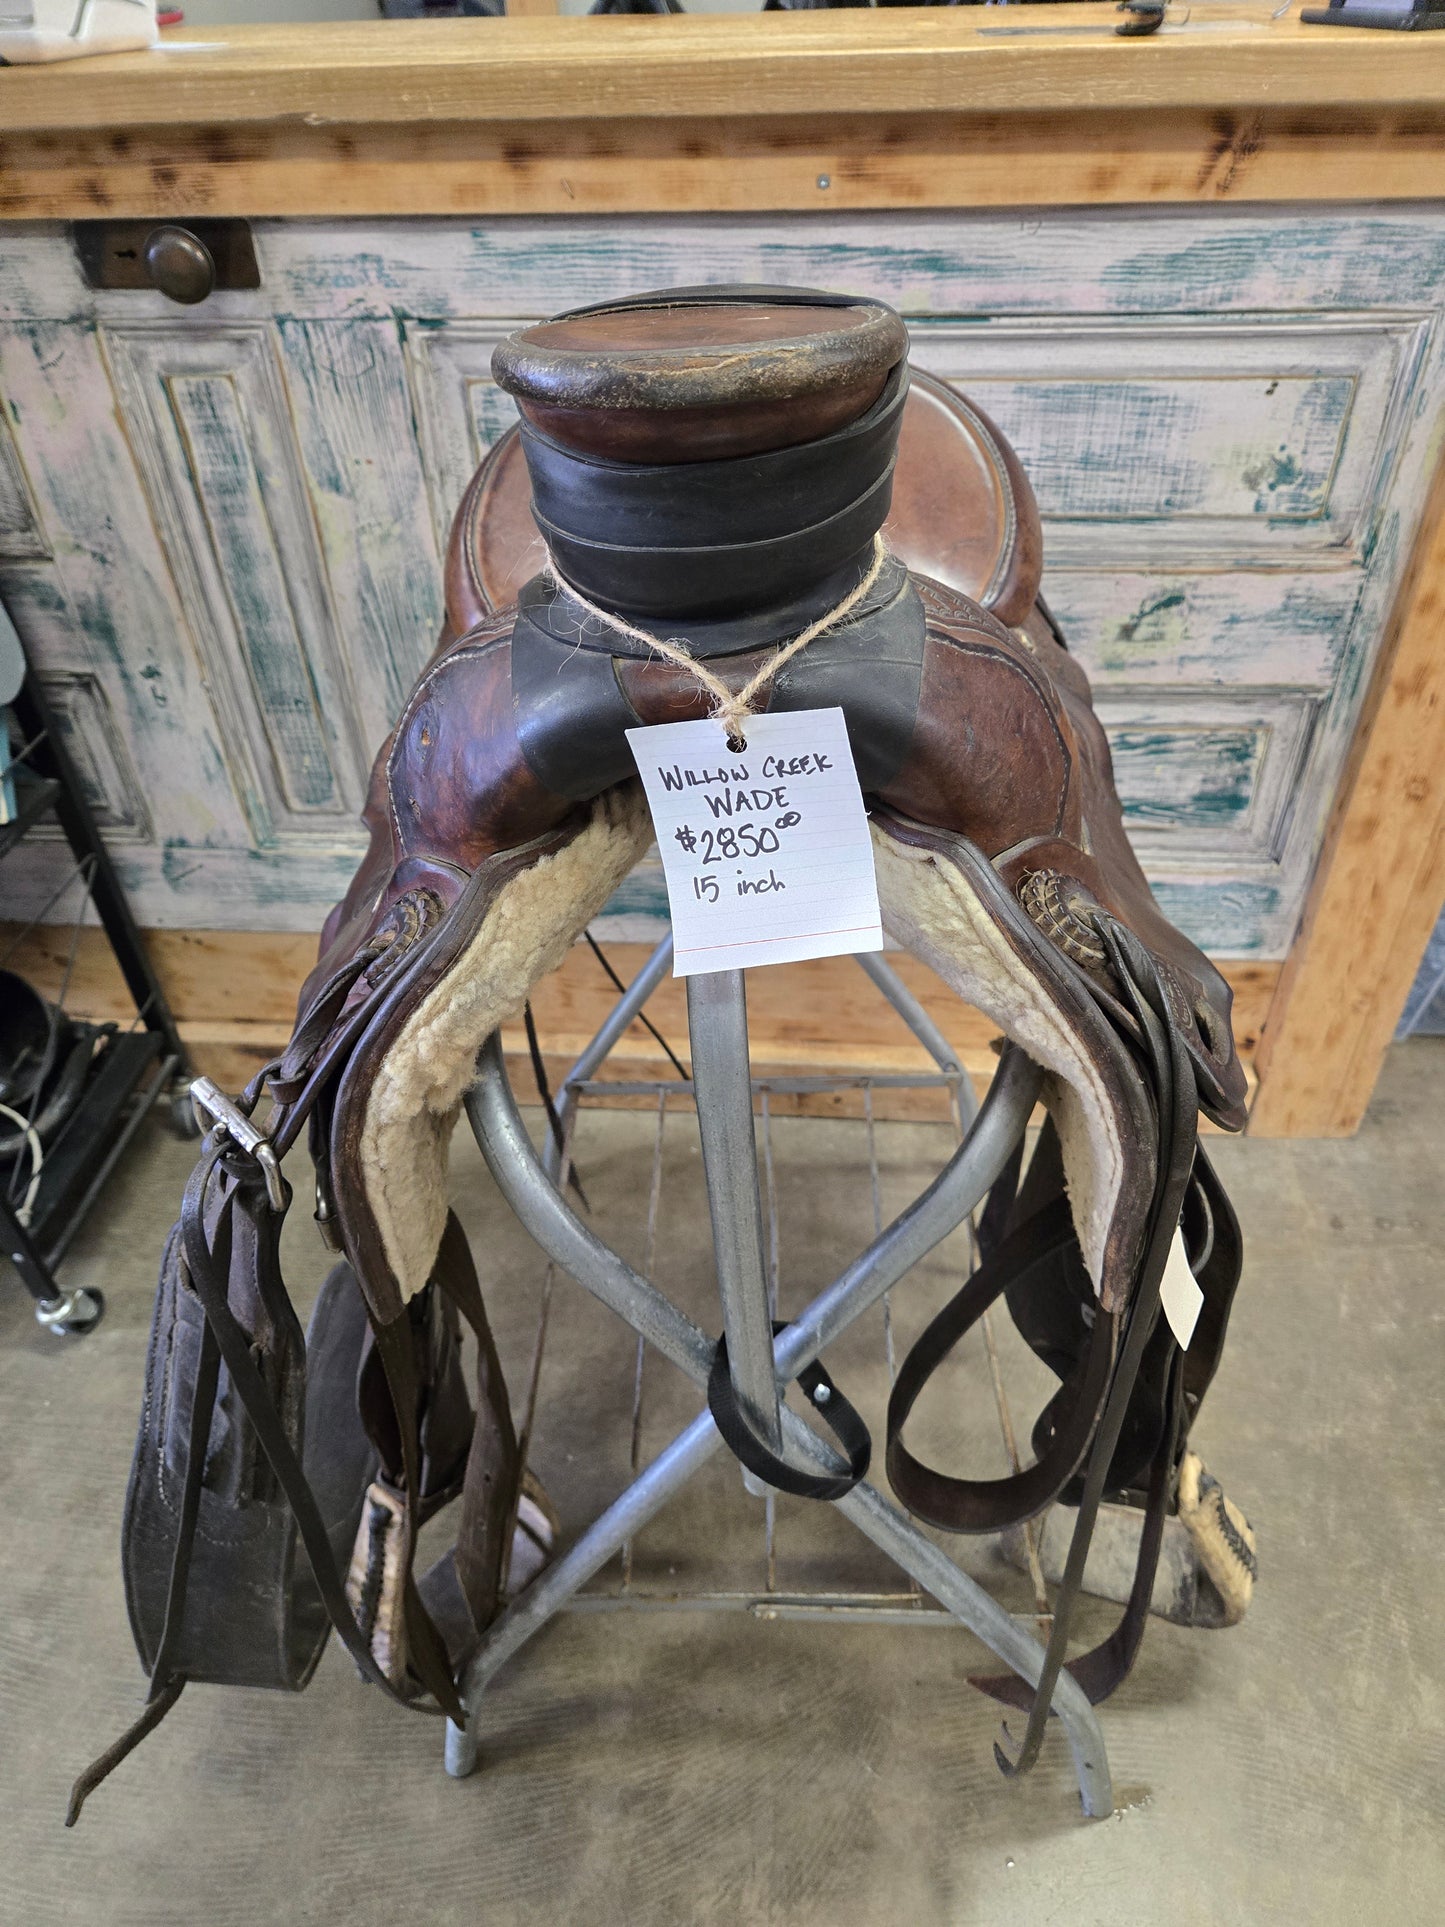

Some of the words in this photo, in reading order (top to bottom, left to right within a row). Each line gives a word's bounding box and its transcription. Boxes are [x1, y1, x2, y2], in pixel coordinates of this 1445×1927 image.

[658, 763, 749, 791] WILLOW
[762, 753, 833, 778] CREEK
[704, 787, 789, 818] WADE
[693, 875, 719, 903] 15
[737, 870, 786, 895] inch
